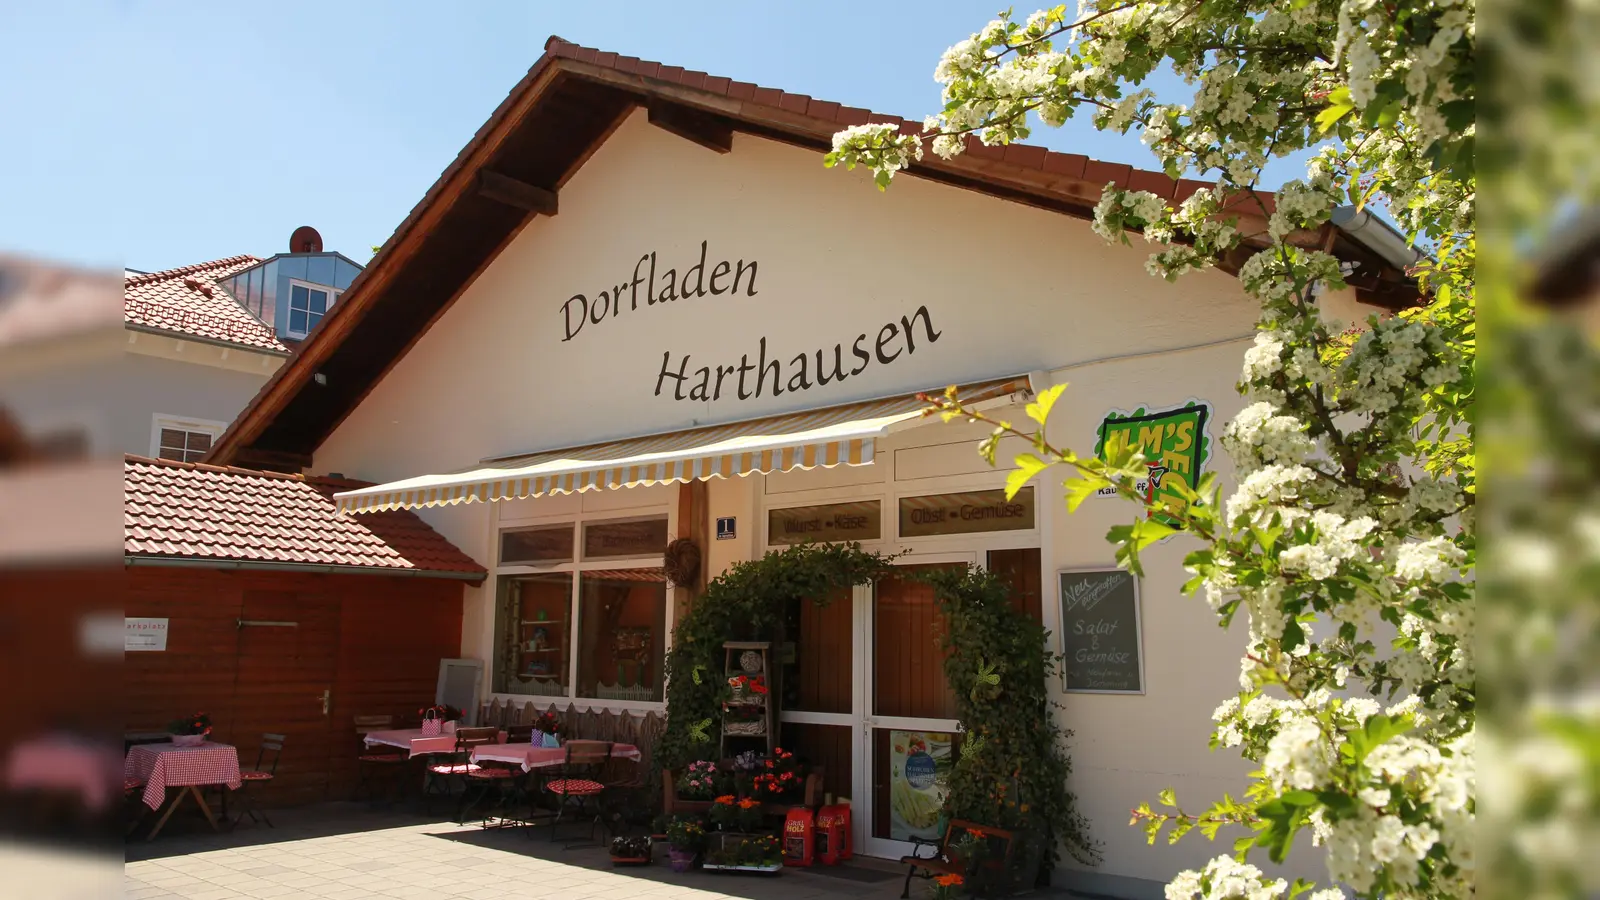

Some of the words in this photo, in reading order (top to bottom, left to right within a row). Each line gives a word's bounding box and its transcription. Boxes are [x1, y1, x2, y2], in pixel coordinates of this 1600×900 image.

[559, 240, 759, 342] Dorfladen
[654, 304, 942, 402] Harthausen
[911, 507, 946, 525] Obst
[960, 501, 1025, 521] Gemüse
[723, 519, 729, 533] 1
[783, 515, 822, 533] Wurst
[1064, 578, 1092, 605] Neu
[126, 621, 166, 630] arkplatz
[1073, 619, 1119, 636] Salat
[1075, 647, 1130, 664] Gemüse
[786, 825, 804, 833] HOLZ
